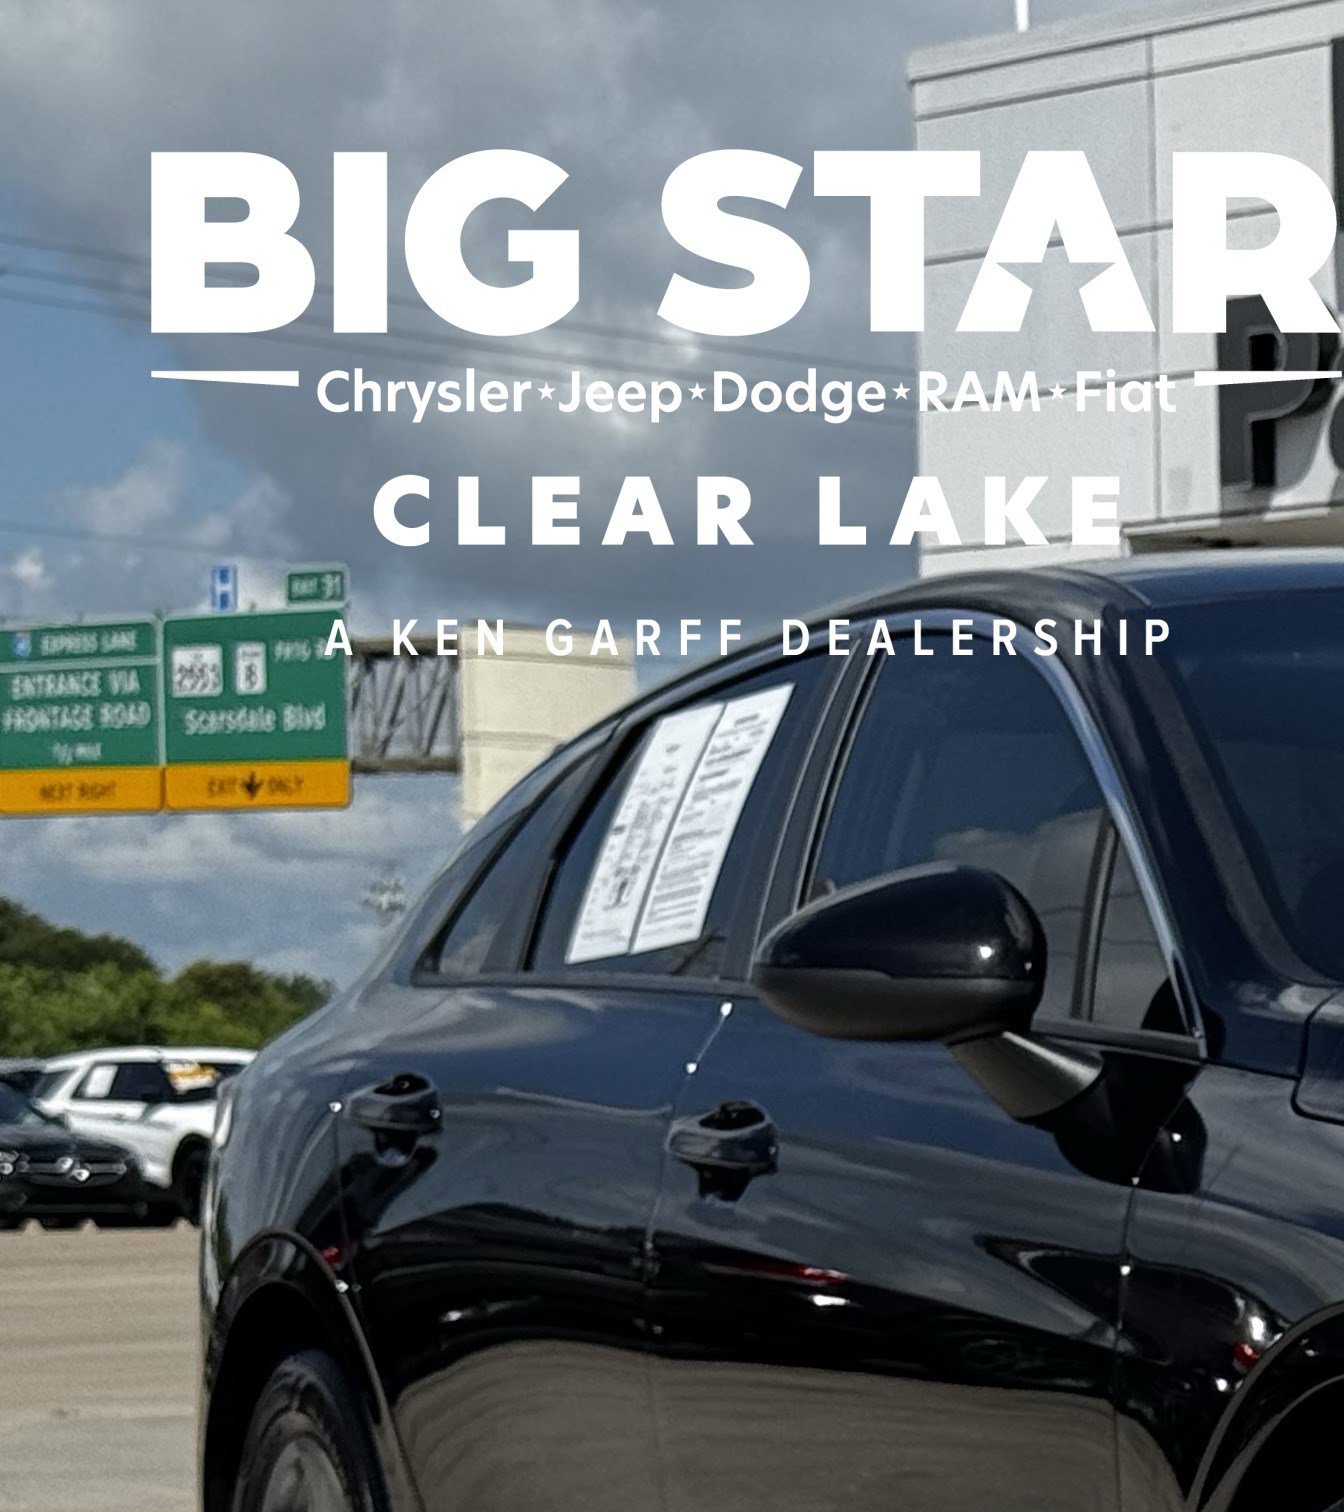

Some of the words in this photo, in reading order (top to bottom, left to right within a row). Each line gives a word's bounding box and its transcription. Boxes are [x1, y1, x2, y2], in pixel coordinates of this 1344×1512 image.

[11, 671, 102, 699] ENTRANCE
[1, 704, 94, 732] FRONTAGE
[100, 701, 151, 728] ROAD
